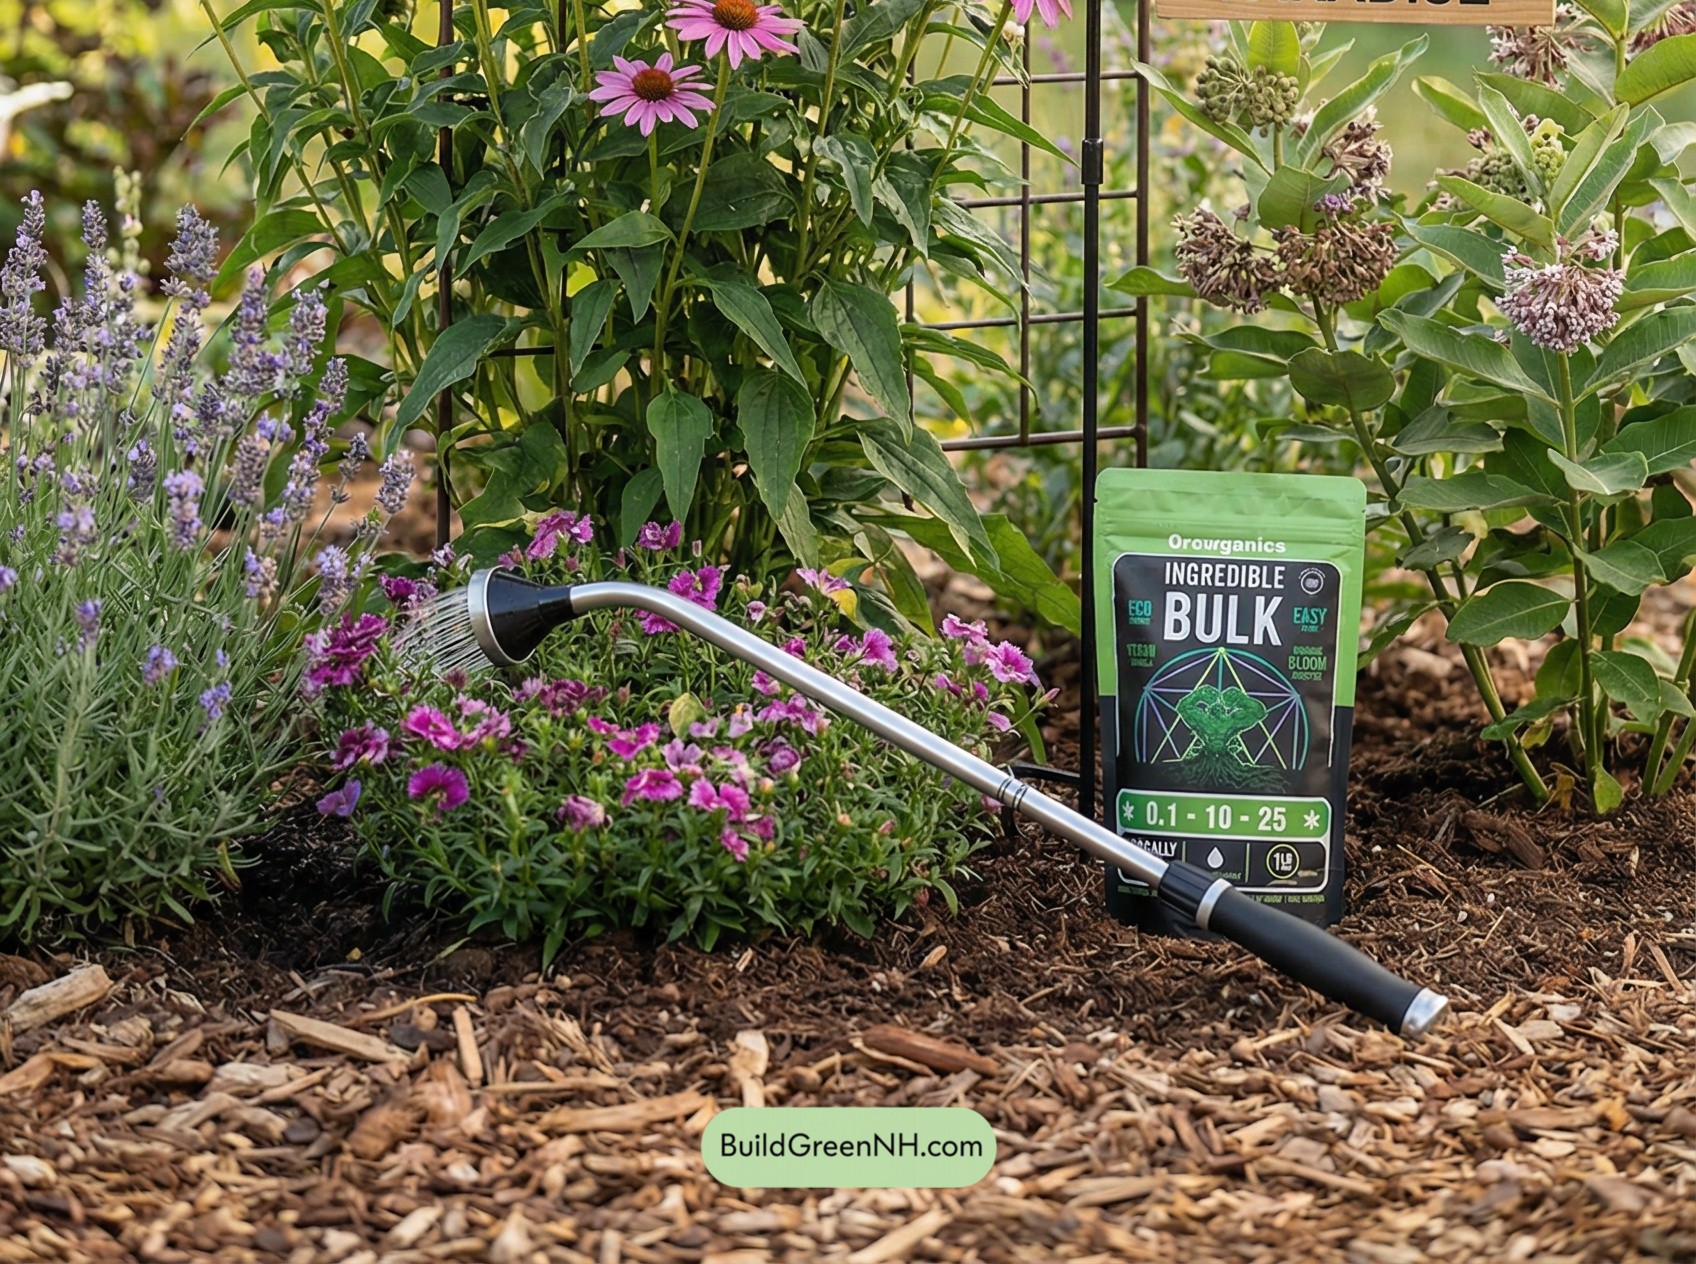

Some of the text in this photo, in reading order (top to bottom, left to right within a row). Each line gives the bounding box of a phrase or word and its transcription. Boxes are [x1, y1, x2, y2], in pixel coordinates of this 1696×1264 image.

[1164, 561, 1286, 589] INGREDIBLE
[1128, 599, 1152, 617] ECO
[1163, 591, 1284, 646] BULK
[1293, 606, 1328, 625] EASY
[1288, 655, 1327, 672] BLOOM
[1146, 800, 1177, 827] 0.1
[1205, 804, 1232, 830] 10
[1257, 805, 1287, 833] 25
